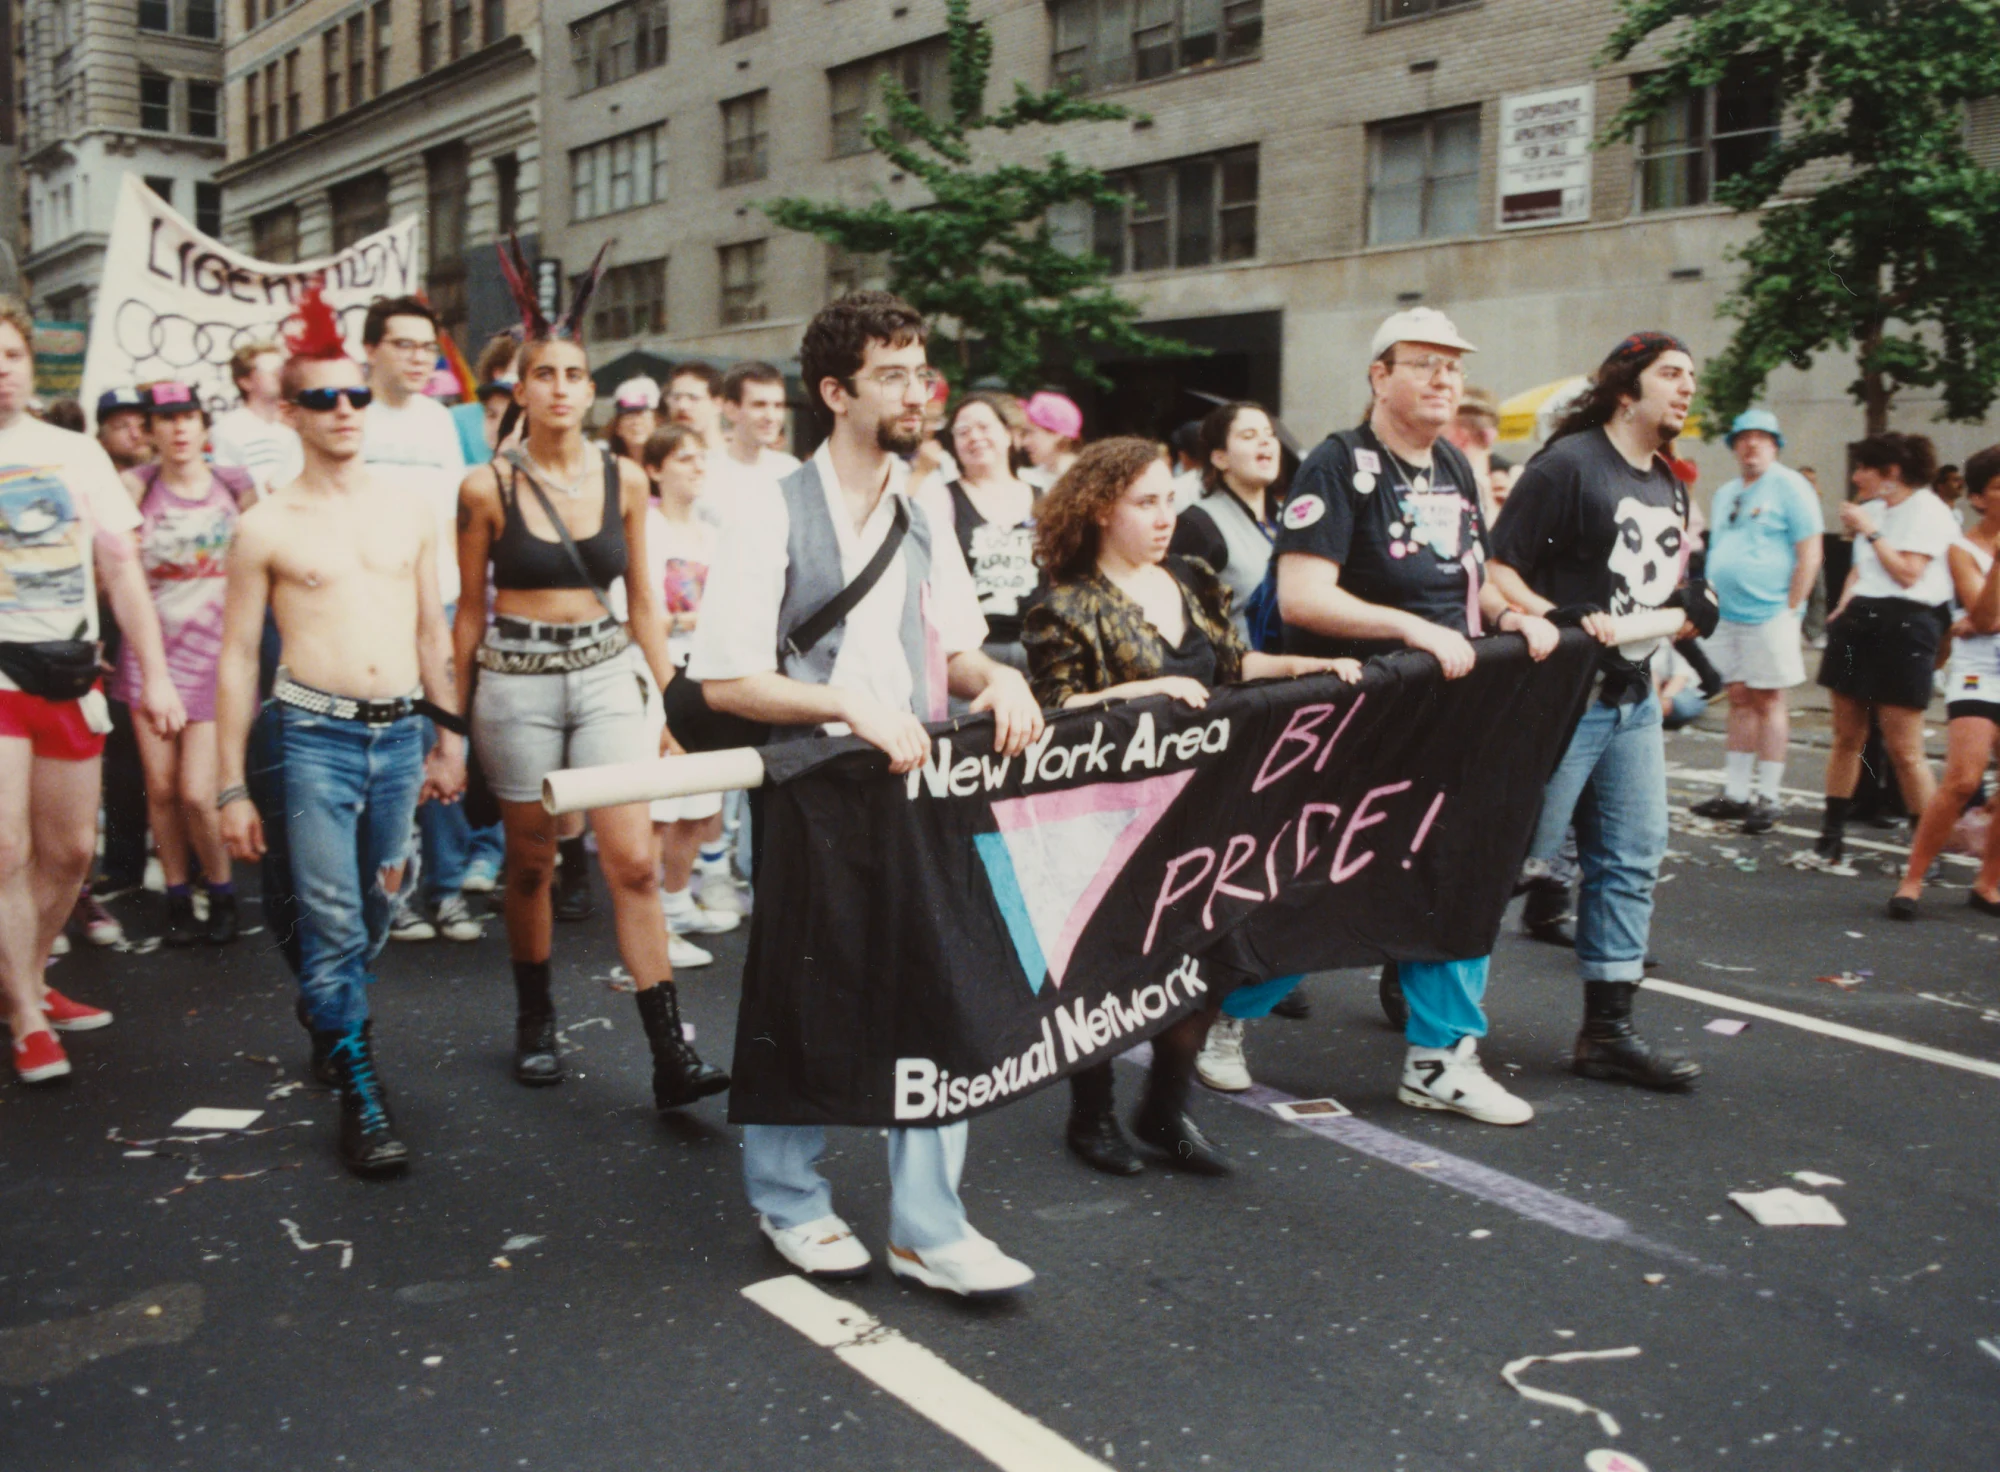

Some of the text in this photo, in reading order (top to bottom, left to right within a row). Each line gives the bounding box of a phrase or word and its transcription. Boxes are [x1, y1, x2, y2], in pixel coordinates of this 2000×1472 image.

[906, 711, 1230, 800] New York Area
[1251, 692, 1366, 793] BI
[894, 953, 1208, 1120] Bisexual Network
